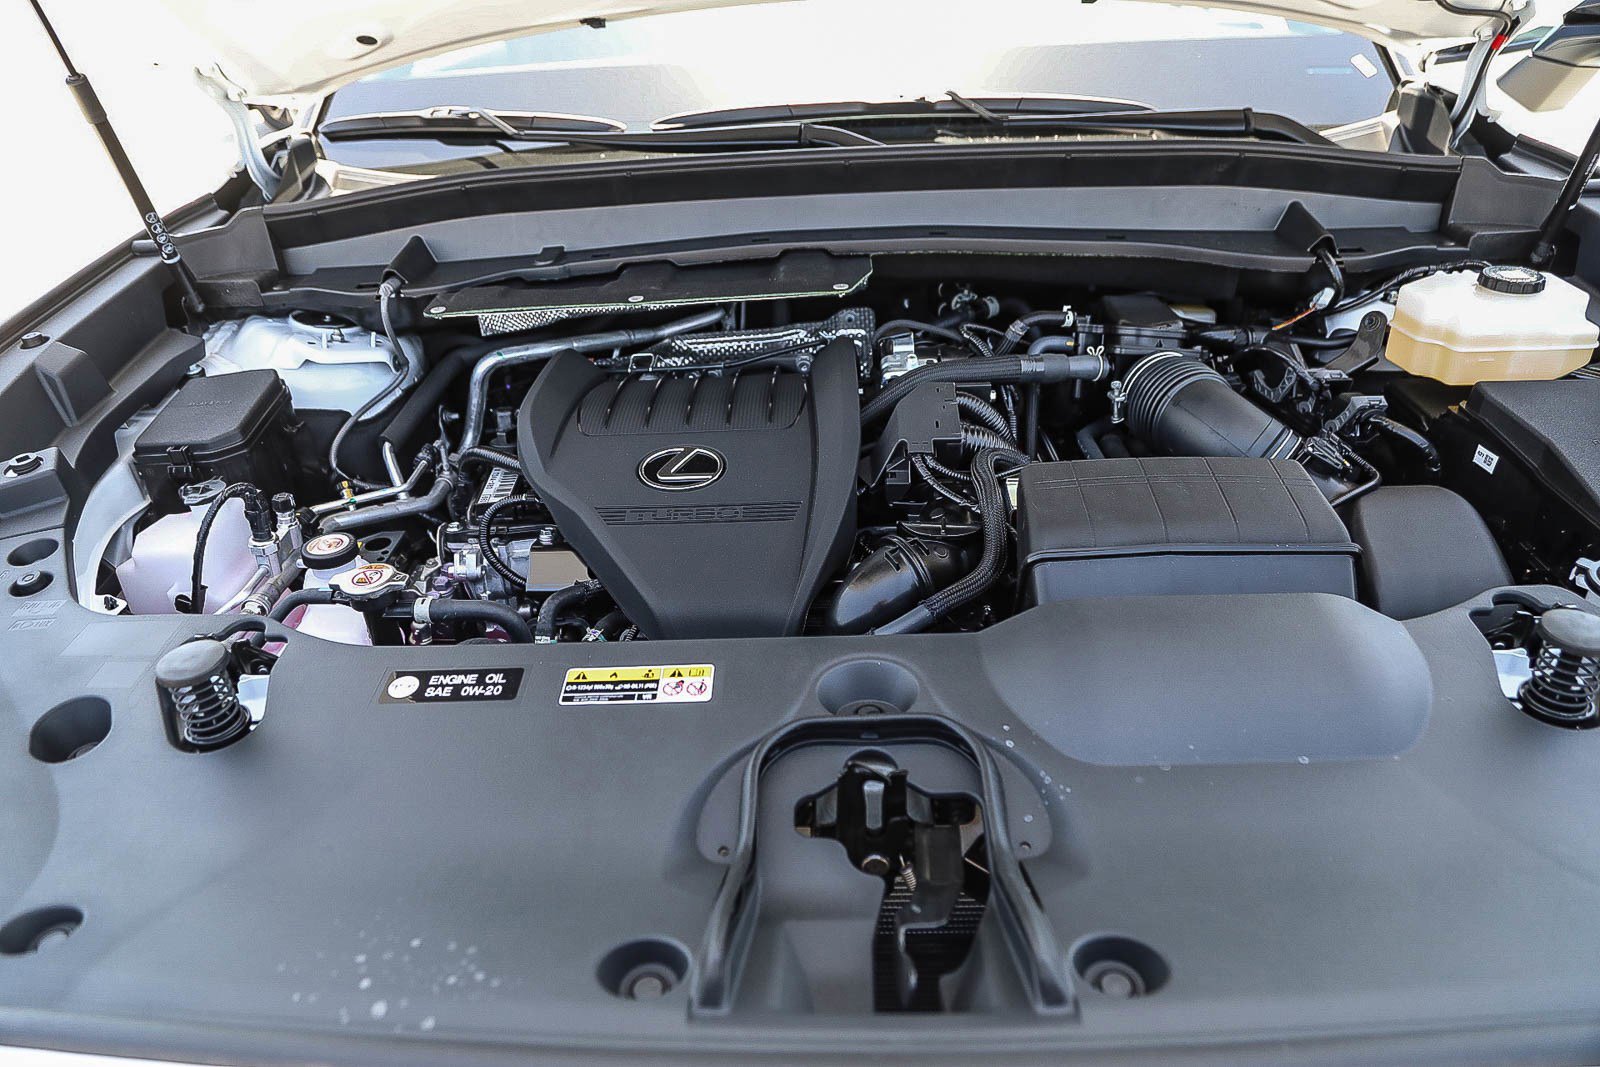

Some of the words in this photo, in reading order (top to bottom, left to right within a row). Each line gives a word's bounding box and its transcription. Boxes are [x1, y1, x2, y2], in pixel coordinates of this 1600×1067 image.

[624, 507, 745, 523] TURBO
[428, 674, 478, 685] ENGINE
[485, 673, 507, 684] OIL
[424, 686, 453, 697] SAE
[460, 685, 502, 696] 0W-20
